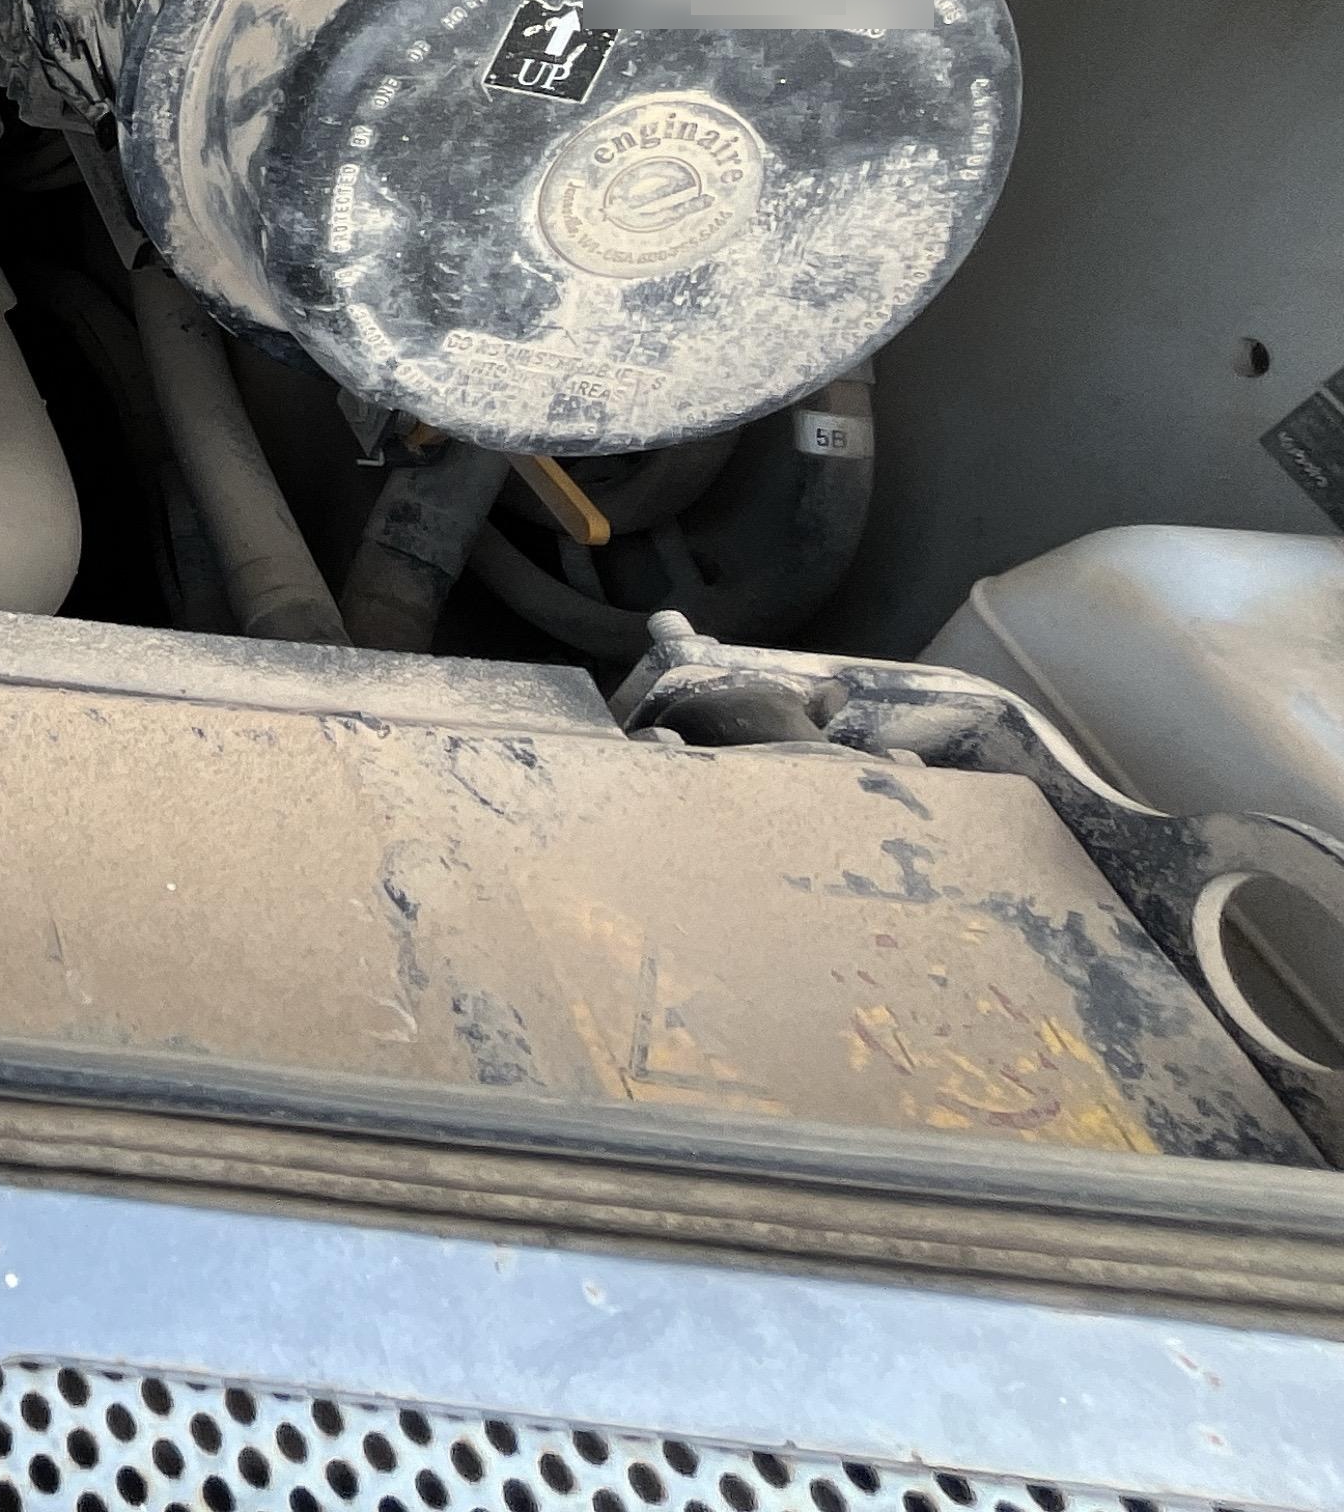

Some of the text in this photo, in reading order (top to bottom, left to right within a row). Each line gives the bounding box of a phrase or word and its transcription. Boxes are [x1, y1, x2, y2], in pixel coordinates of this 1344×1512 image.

[517, 58, 571, 91] UP
[593, 112, 744, 185] enginaire
[816, 428, 848, 449] 5B
